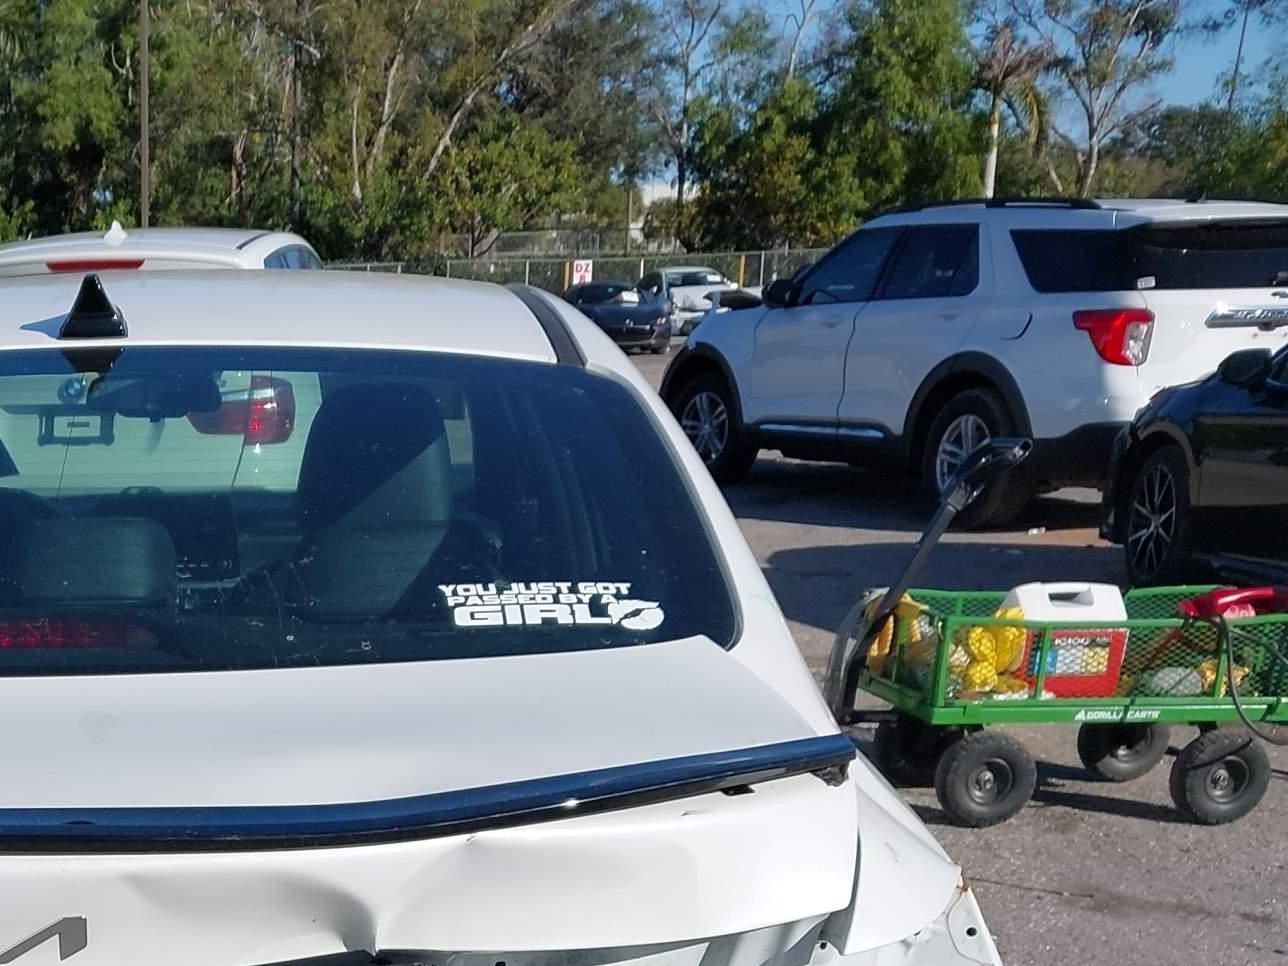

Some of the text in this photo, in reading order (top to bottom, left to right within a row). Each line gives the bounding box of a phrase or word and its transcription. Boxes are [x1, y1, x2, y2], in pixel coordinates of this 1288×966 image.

[438, 582, 633, 596] YOU JUST GOT
[447, 593, 618, 606] PASSED BY A
[454, 604, 613, 626] GIRL
